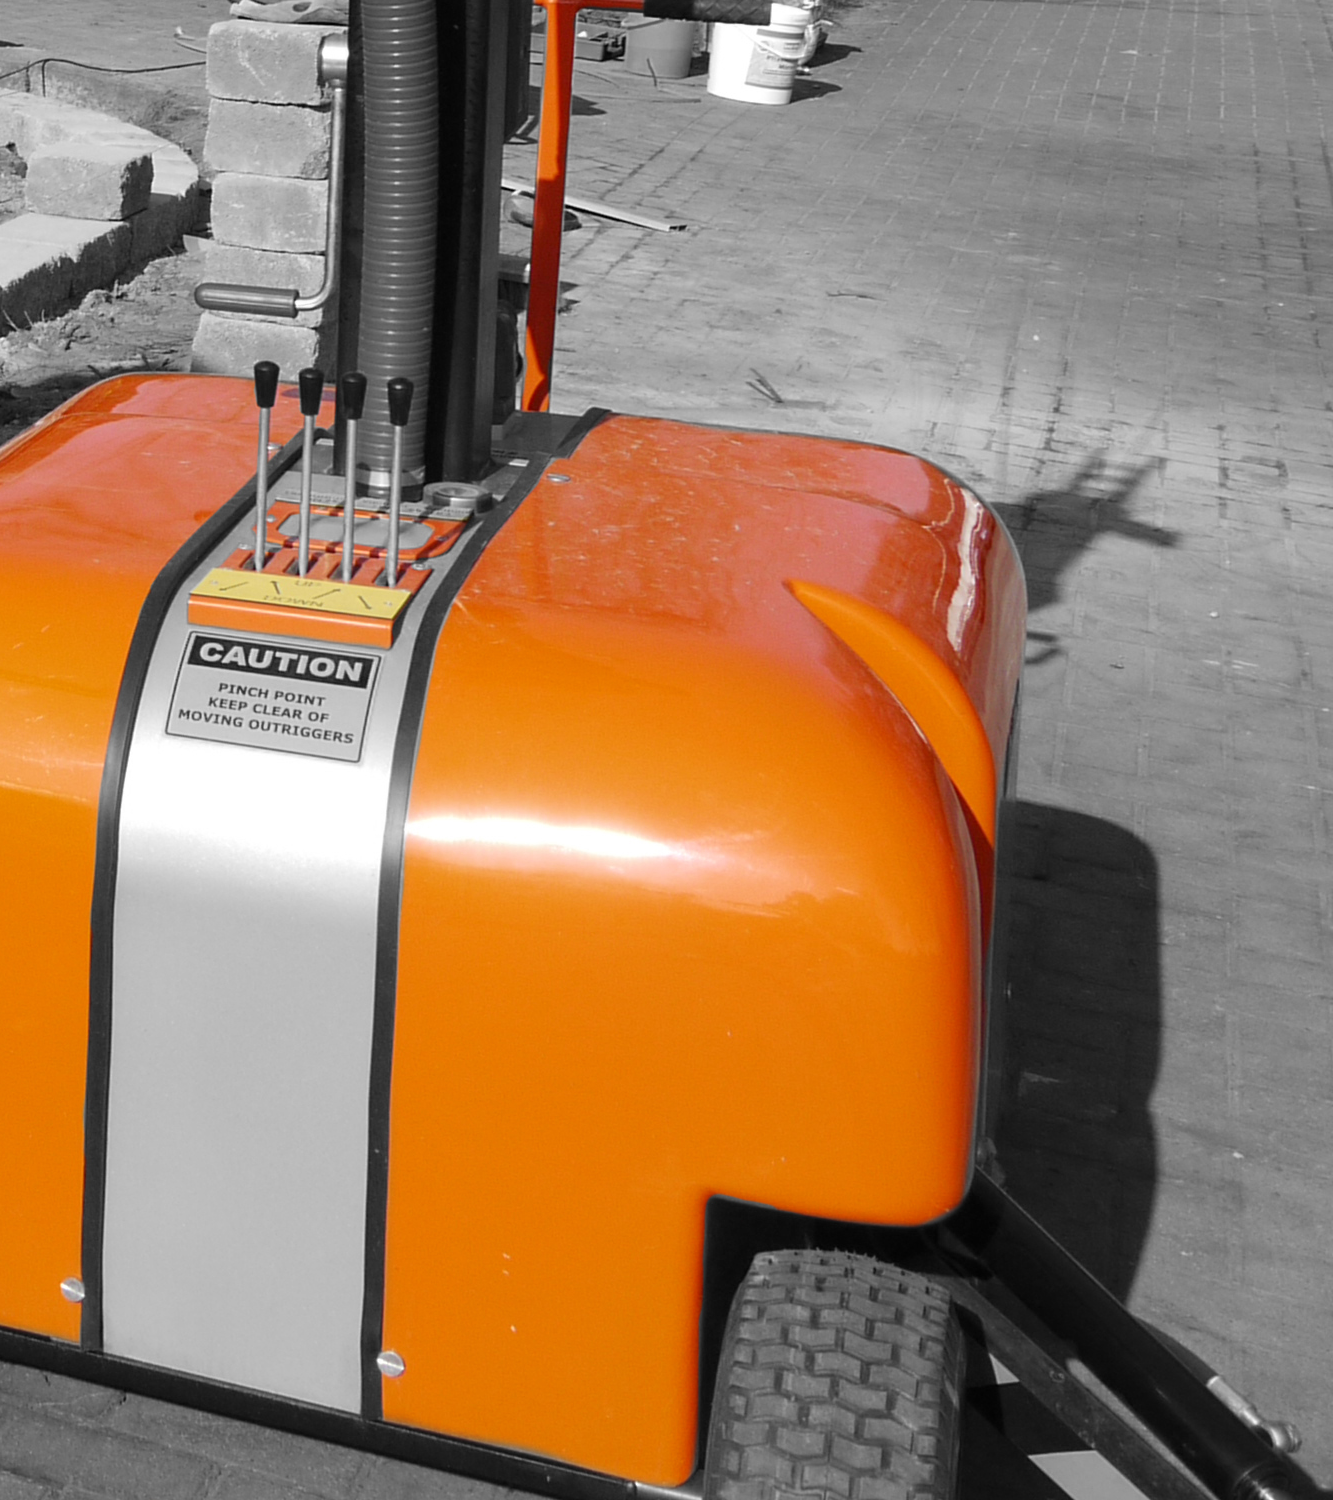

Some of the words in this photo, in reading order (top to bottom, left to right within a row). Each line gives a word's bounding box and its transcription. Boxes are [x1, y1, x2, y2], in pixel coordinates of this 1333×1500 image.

[263, 595, 324, 607] DOWN
[199, 642, 363, 681] CAUTION
[218, 682, 269, 700] PINCH
[274, 688, 326, 707] POINT
[208, 697, 248, 712] KEEP
[252, 703, 303, 721] CLEAR
[308, 710, 330, 724] OF
[178, 708, 243, 728] MOVING
[248, 718, 354, 744] OUTRIGGERS
